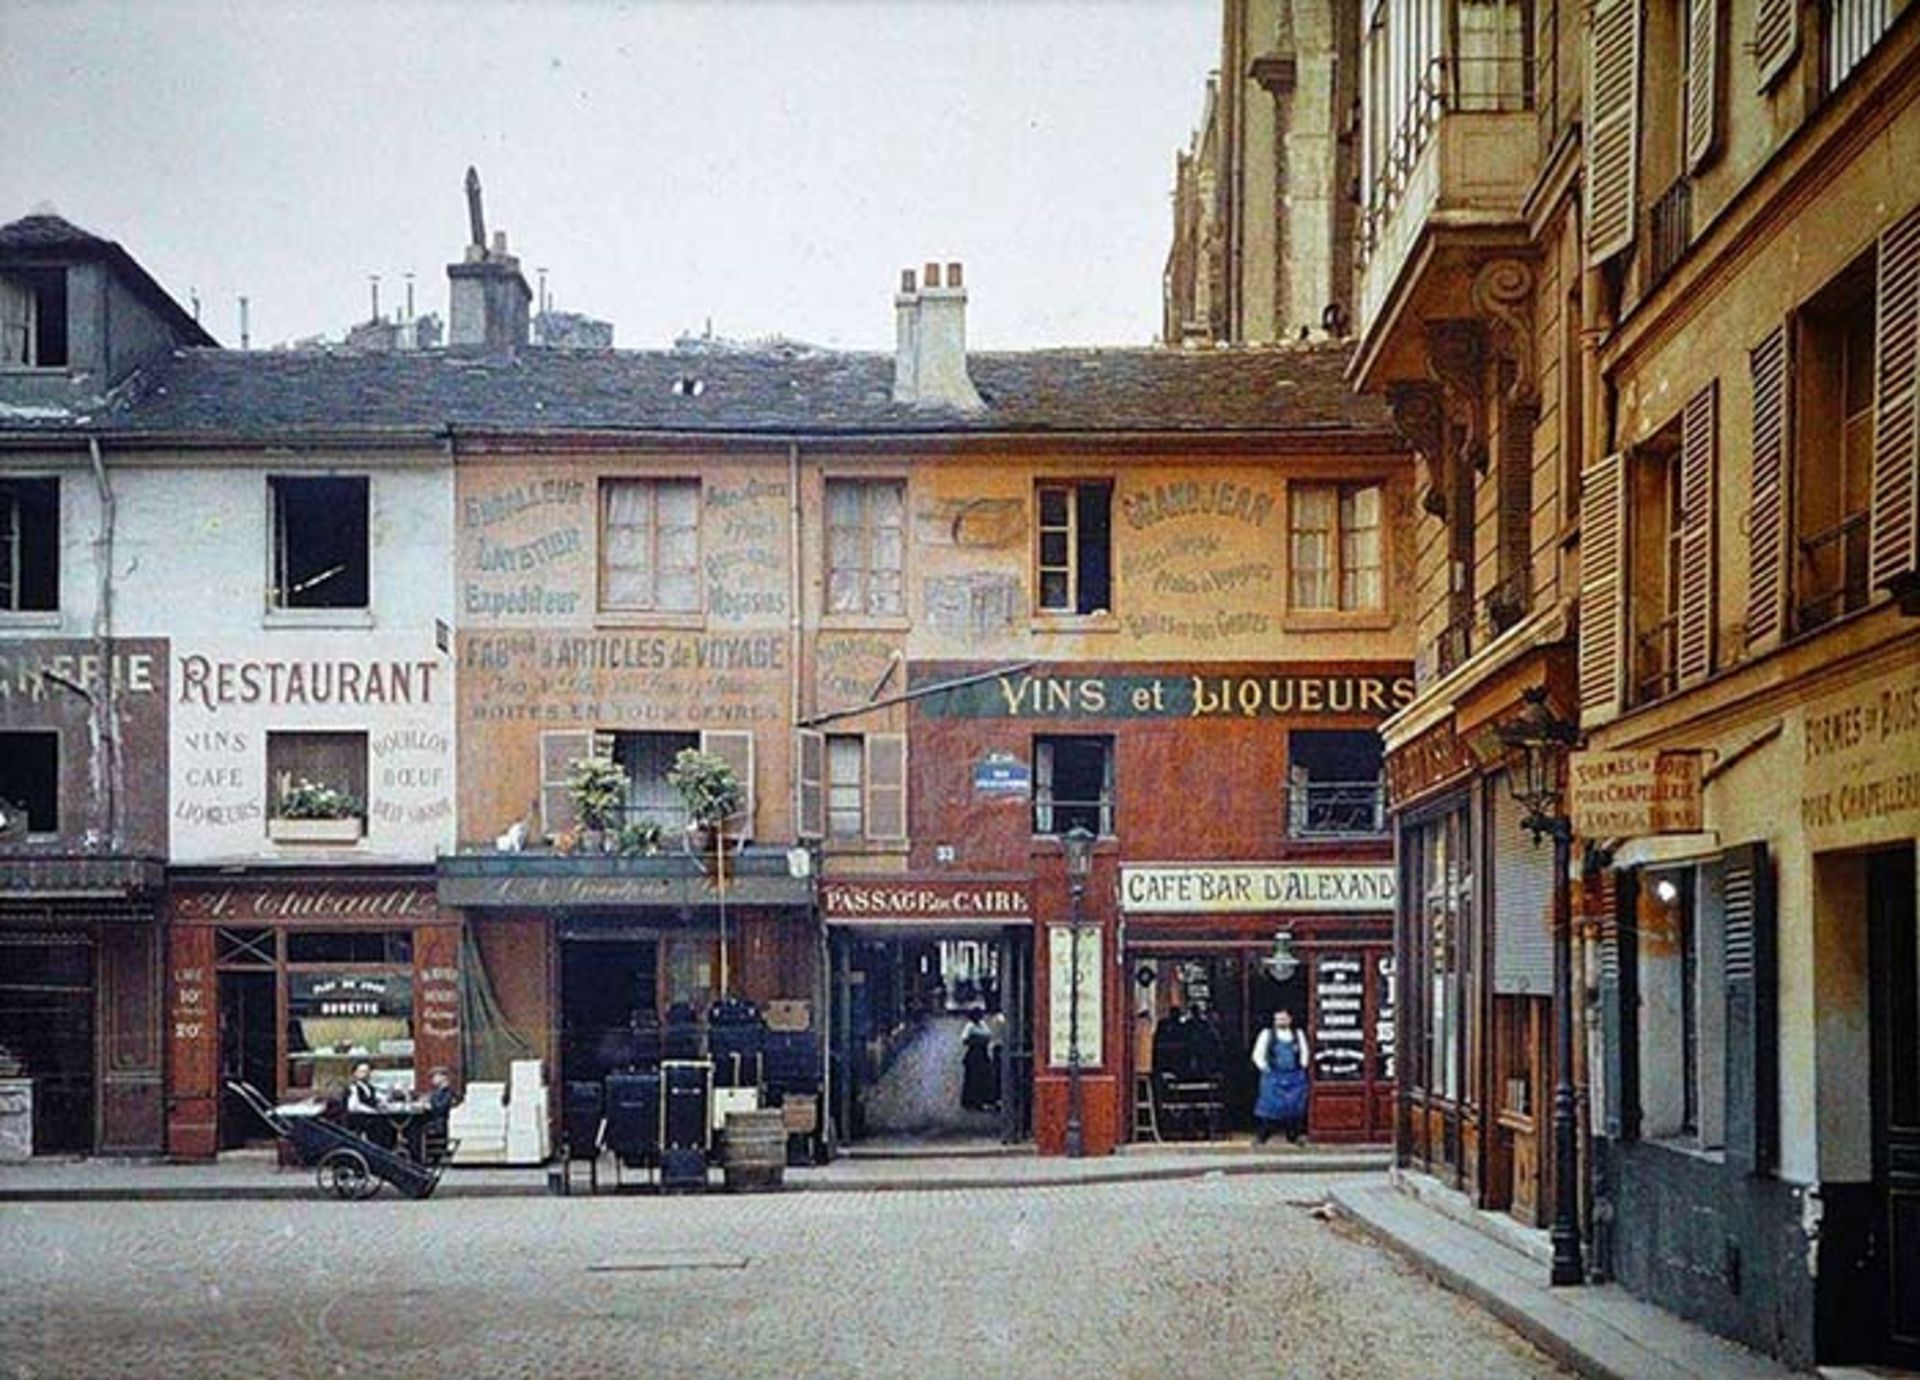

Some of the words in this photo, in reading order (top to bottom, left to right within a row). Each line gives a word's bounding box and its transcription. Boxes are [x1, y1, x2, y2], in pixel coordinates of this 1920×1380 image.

[694, 634, 785, 669] VOYAGE
[180, 655, 439, 711] RESTAURANT
[1000, 675, 1106, 715] VINS
[1131, 679, 1164, 712] et
[1191, 674, 1415, 716] LIQUEURS
[184, 730, 248, 753] VINS
[826, 889, 936, 913] PASSAGE
[952, 889, 1030, 913] CAIRE
[1199, 871, 1252, 902] BAR
